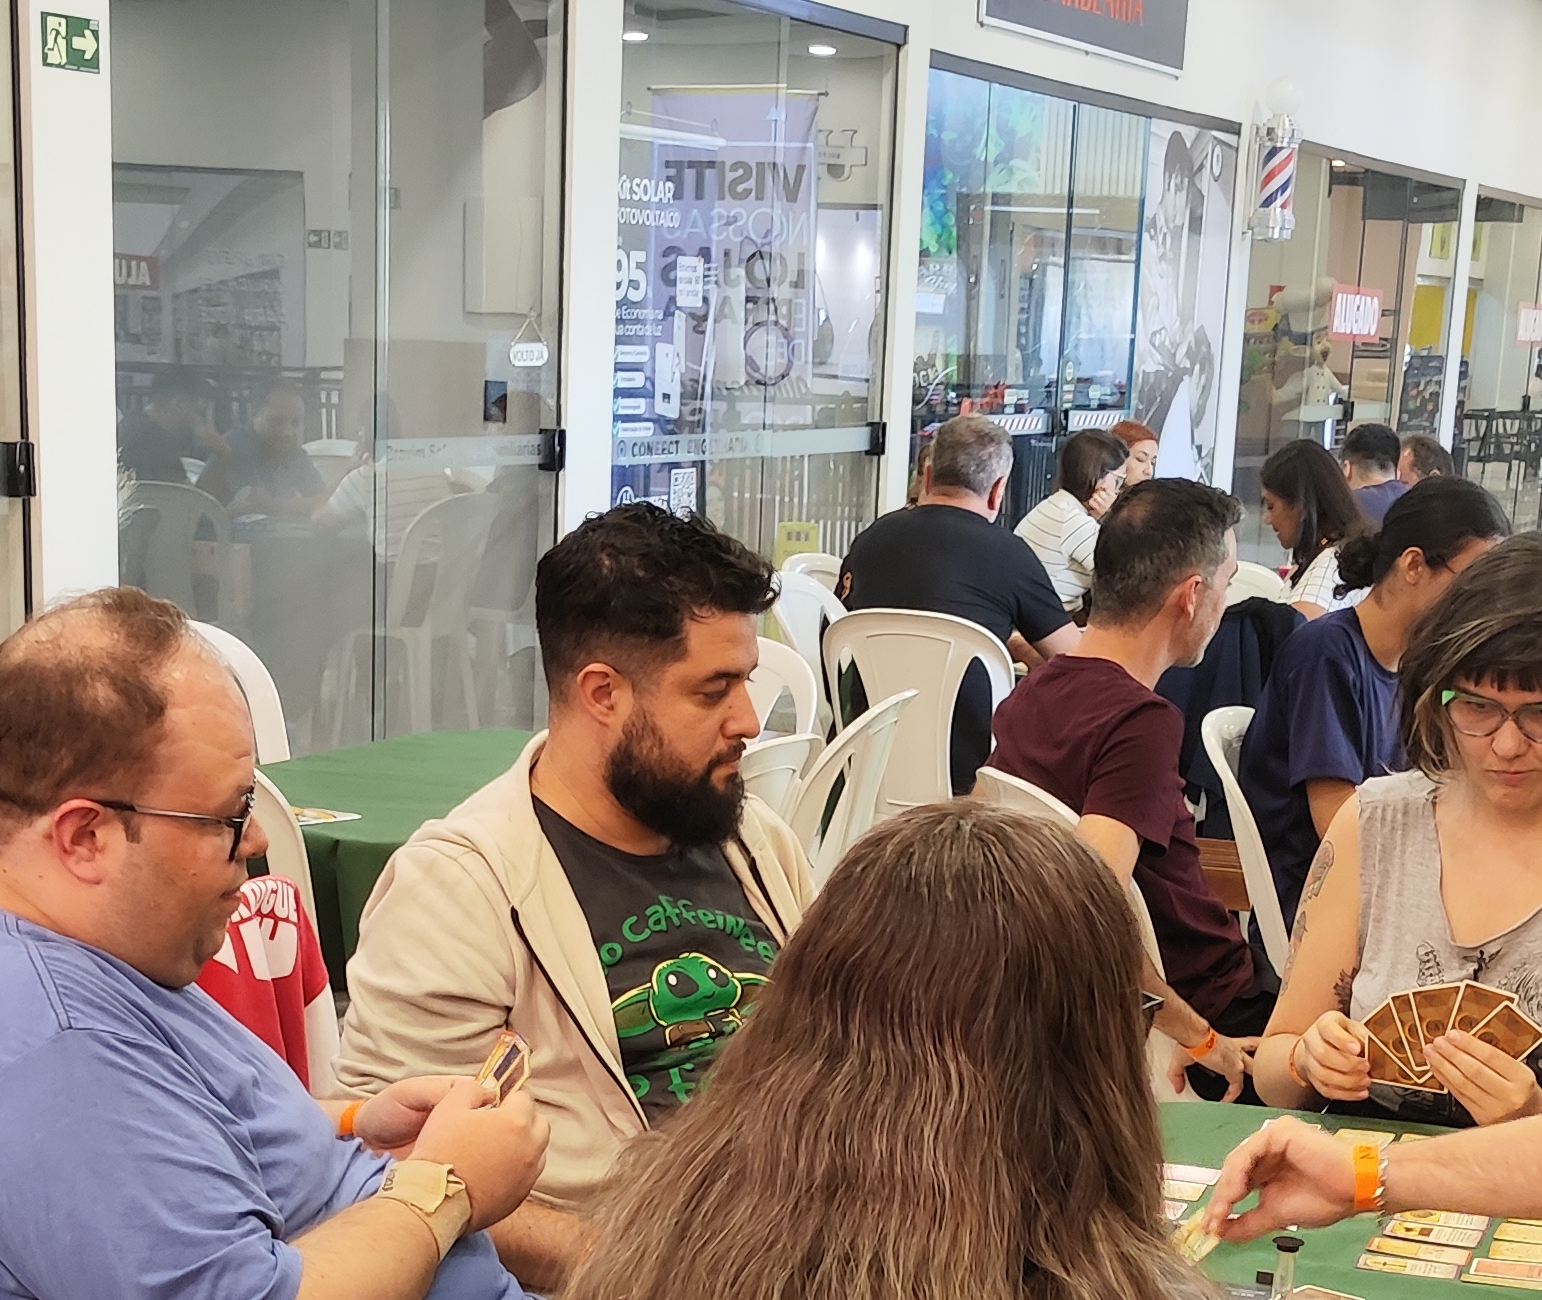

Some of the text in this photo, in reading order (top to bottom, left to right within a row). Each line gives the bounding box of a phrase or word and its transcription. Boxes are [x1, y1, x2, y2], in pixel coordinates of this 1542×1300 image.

[633, 177, 675, 204] SOLAR
[617, 206, 681, 229] OTOVOLTAICO
[615, 248, 647, 303] 95
[1332, 293, 1380, 336] ALUGADO
